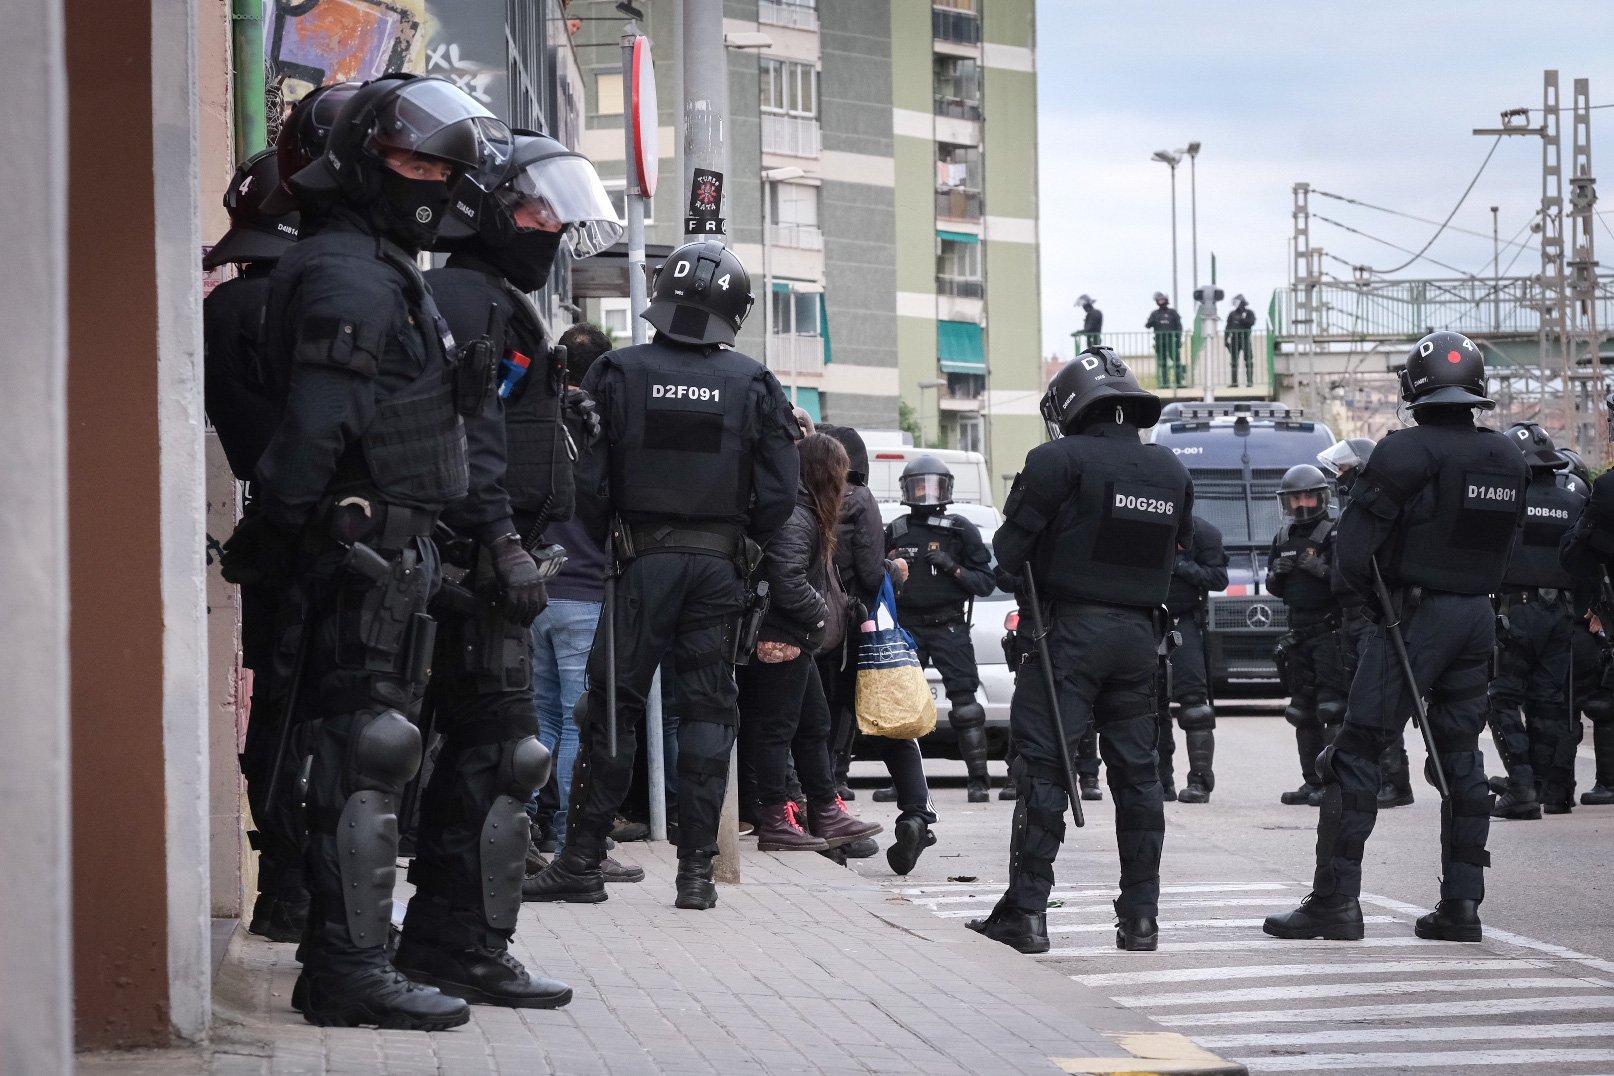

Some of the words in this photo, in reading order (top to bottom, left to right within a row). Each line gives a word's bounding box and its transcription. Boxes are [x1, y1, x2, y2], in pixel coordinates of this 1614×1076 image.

[426, 43, 480, 71] XL
[238, 175, 253, 196] 4
[673, 260, 691, 278] D
[717, 273, 731, 291] 4
[1419, 341, 1434, 358] D
[1462, 339, 1474, 352] 4
[1081, 356, 1099, 371] D
[652, 384, 720, 402] D2F091
[1517, 429, 1529, 440] D
[1468, 485, 1516, 502] D1A801
[1567, 482, 1576, 492] 4
[1115, 493, 1174, 515] D0G296
[1527, 506, 1569, 519] D0B486
